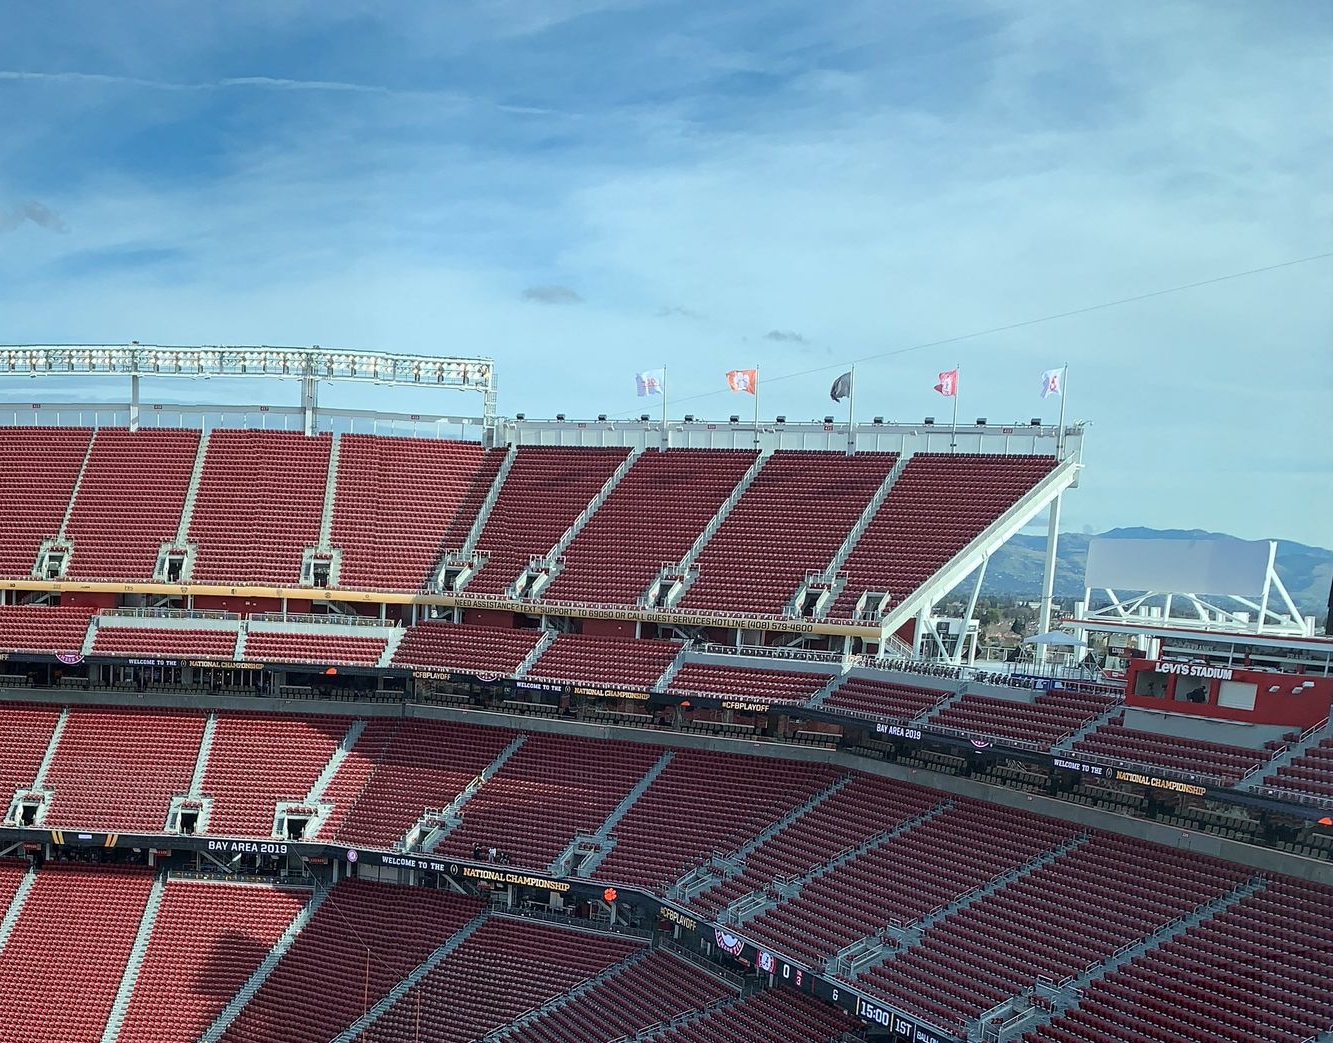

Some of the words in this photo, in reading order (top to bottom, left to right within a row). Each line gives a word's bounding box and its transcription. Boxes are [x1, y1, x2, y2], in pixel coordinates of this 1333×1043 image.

[472, 600, 519, 611] ASSISTANCE?
[520, 605, 536, 613] TEXT
[537, 605, 577, 616] "SUPPORT"
[578, 608, 587, 617] TO
[588, 609, 614, 619] 69050
[615, 611, 626, 619] OR
[627, 612, 646, 621] CALL
[646, 613, 671, 623] GUEST
[672, 615, 710, 625] SERVICES
[711, 618, 746, 628] HOTLINE
[747, 619, 770, 631] (408)
[1190, 665, 1233, 680] STADIUM
[516, 681, 542, 690] WELCOME
[574, 687, 604, 697] NATIONAL
[604, 689, 650, 700] CHAMPIONSHIP
[722, 702, 769, 712] #CFBPLAYOFF
[876, 723, 888, 733] BAY
[889, 725, 905, 737] AREA
[905, 727, 921, 740] 2019
[1054, 758, 1080, 771] WELCOME
[1091, 765, 1103, 775] THE
[1116, 770, 1150, 786] NATIONAL
[1150, 777, 1206, 796] CHAMPIONSHIP
[208, 840, 229, 850] BAY
[231, 841, 259, 853] AREA
[260, 843, 288, 854] 2019
[382, 856, 417, 868] WELCOME
[430, 862, 445, 872] THE
[463, 868, 505, 882] NATIONAL
[506, 873, 571, 892] CHAMPIONSHIP
[860, 1001, 890, 1026] 15:00
[895, 1018, 912, 1037] 1ST
